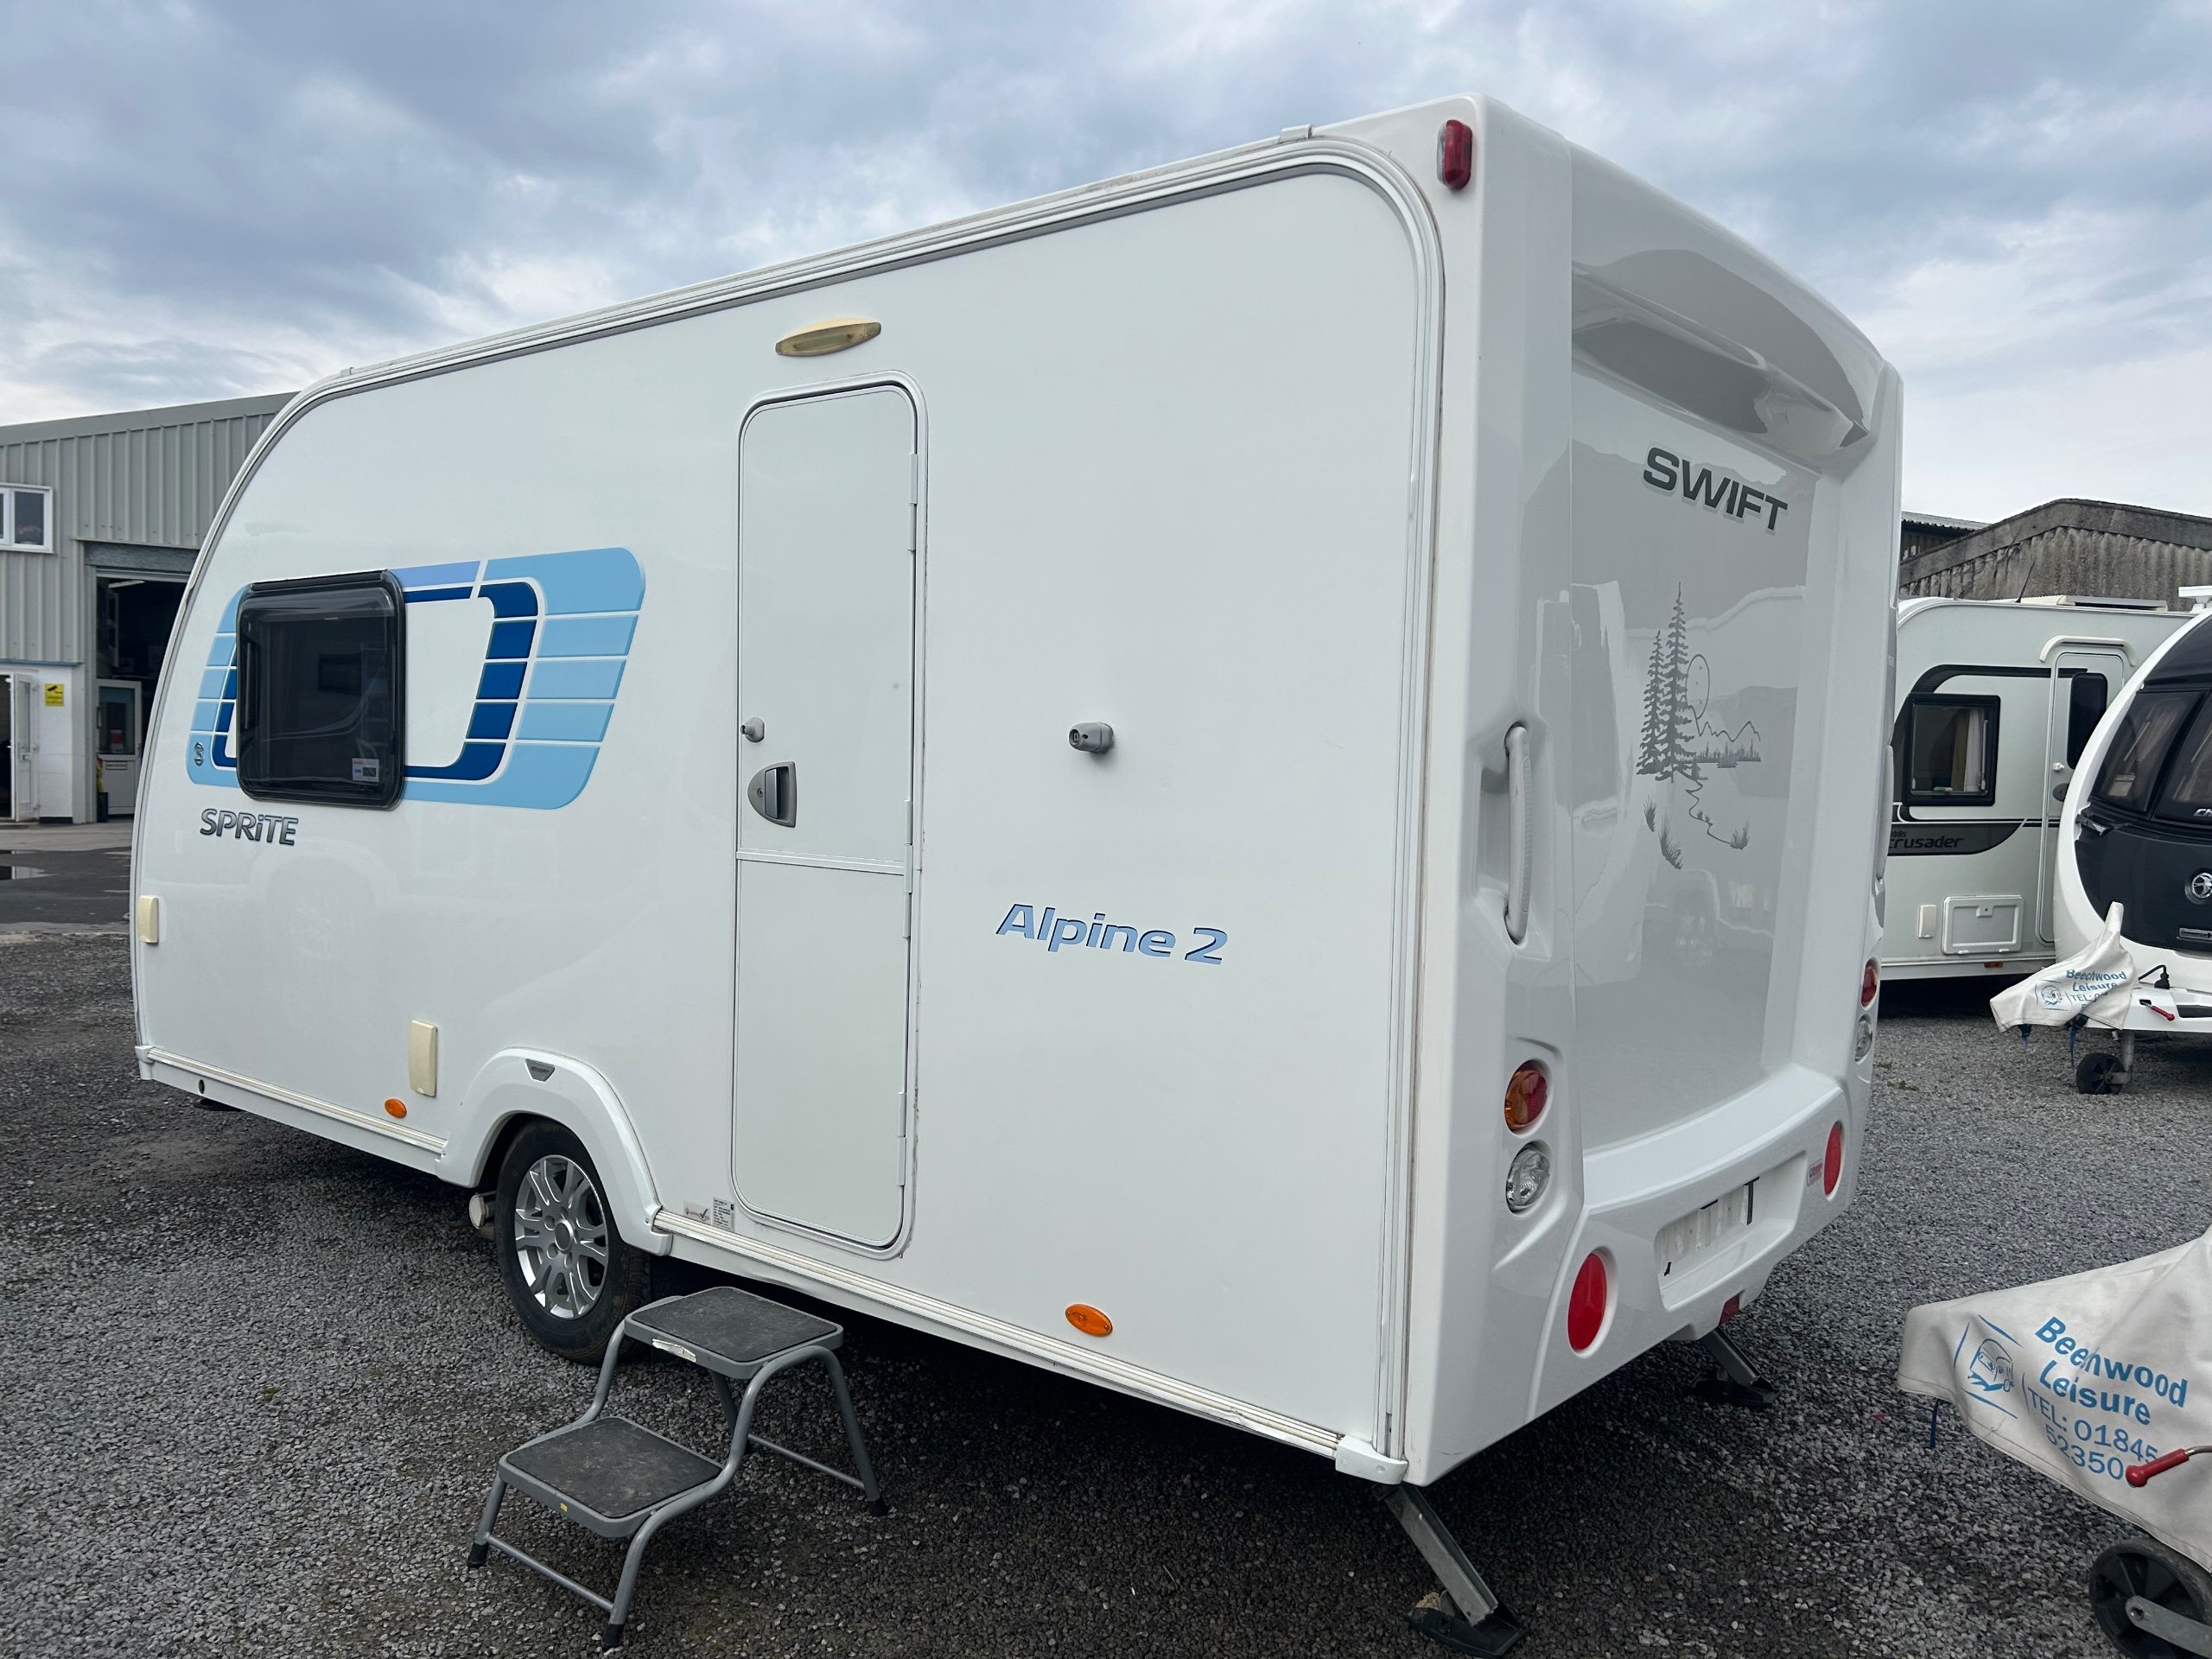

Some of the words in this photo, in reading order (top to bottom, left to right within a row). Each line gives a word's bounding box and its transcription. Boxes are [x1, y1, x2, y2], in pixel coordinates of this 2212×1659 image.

[1643, 446, 1789, 531] SWIFT
[995, 903, 1177, 958] Alpine
[1184, 926, 1229, 966] 2
[2066, 969, 2127, 982] Beechwood
[2072, 982, 2118, 993] Leisure
[2034, 1316, 2189, 1408] Beehwood
[2039, 1359, 2151, 1427] Leisure
[2027, 1386, 2068, 1433] TEL:
[2073, 1419, 2159, 1464] 01845
